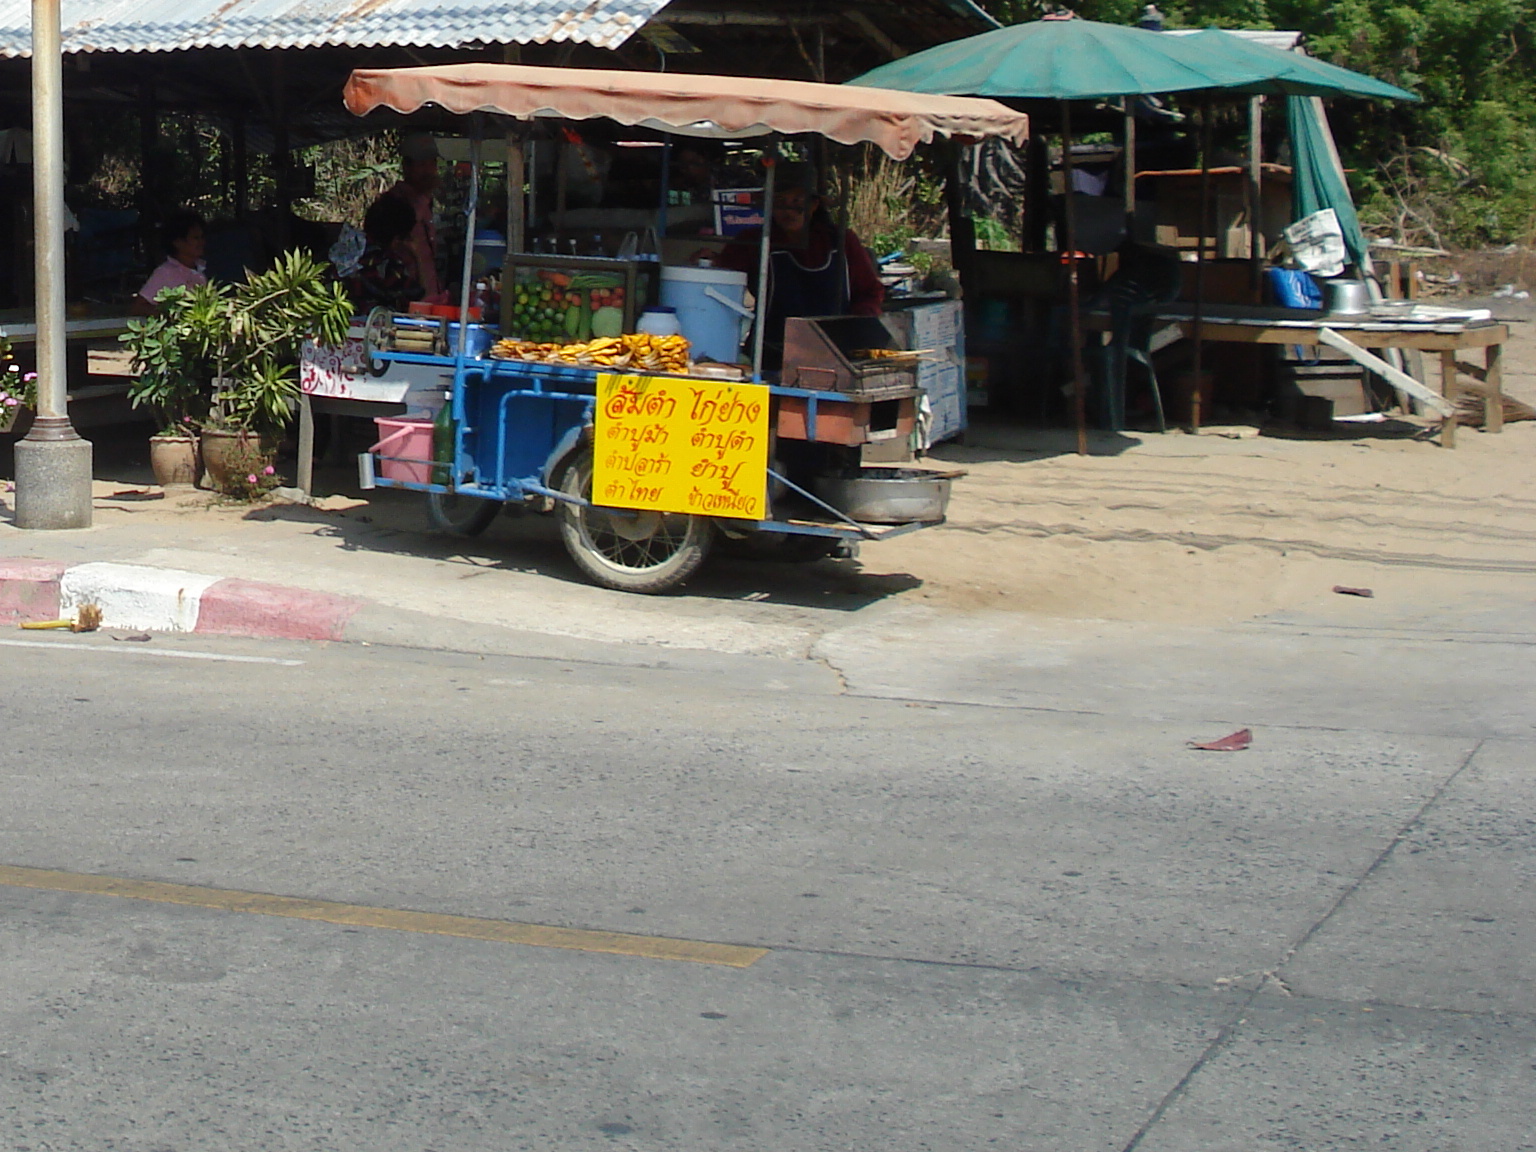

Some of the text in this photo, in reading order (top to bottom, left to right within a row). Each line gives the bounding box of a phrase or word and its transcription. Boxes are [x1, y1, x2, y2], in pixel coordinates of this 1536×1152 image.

[605, 385, 677, 419] ส้มตำ
[689, 387, 761, 425] ไก่ย่าง
[607, 422, 669, 452] ตำปูม้า
[605, 450, 671, 476] ตำปลาร้า
[690, 458, 747, 490] ยำปู
[688, 485, 757, 515] ข้าวเหนียว
